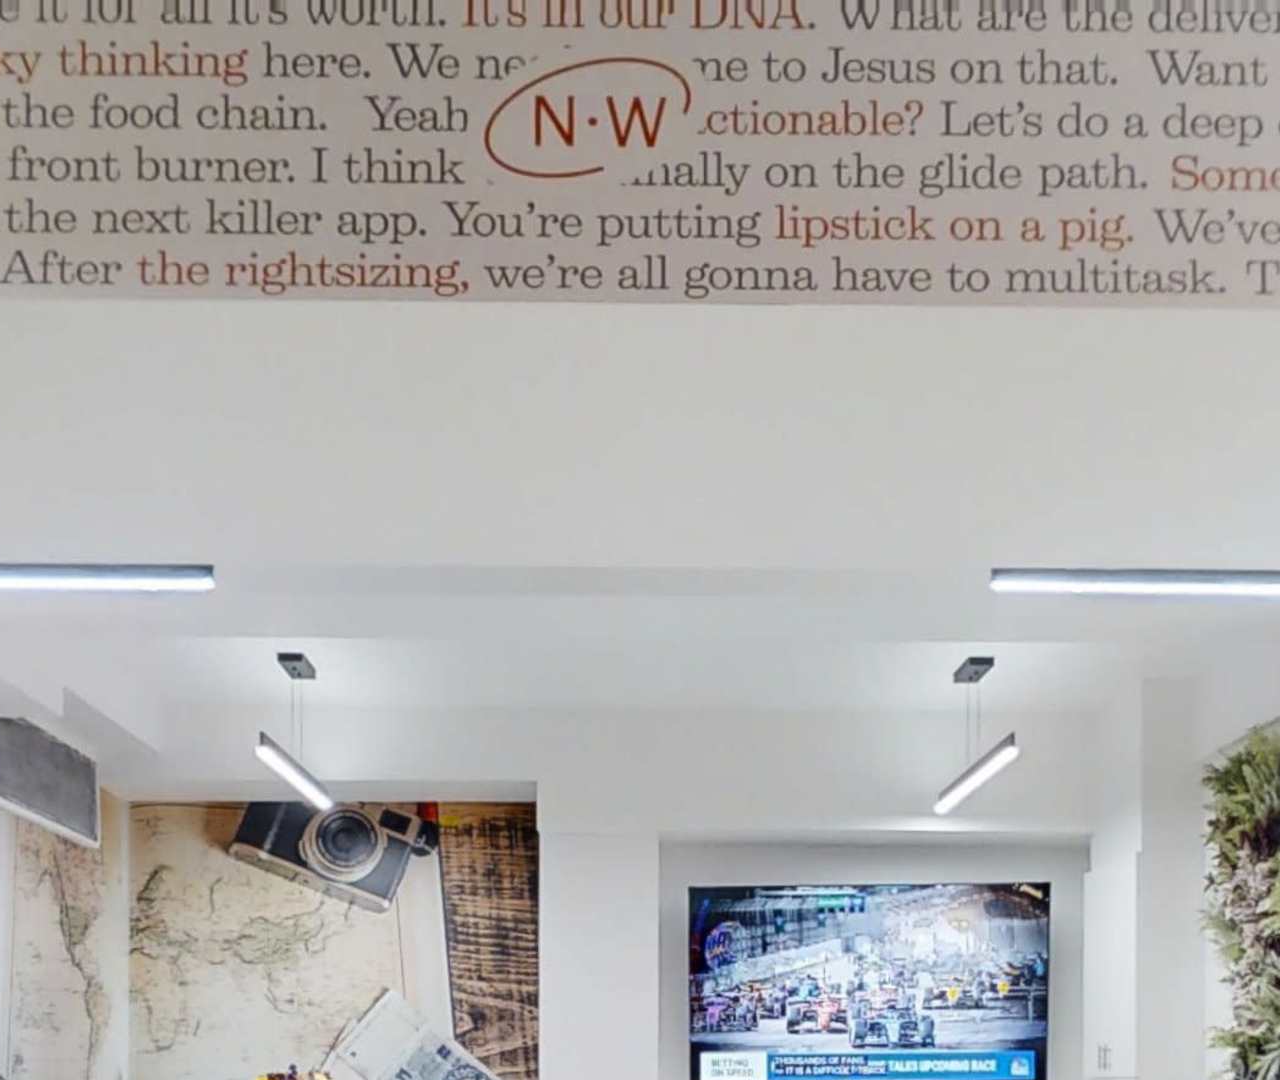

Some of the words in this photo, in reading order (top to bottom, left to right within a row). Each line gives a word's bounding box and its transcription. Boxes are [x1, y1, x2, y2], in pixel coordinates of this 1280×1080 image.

[691, 0, 816, 32] DNA.
[840, 0, 962, 33] What
[976, 5, 1047, 33] are
[1064, 0, 1133, 34] the
[59, 39, 249, 90] thinking
[263, 40, 371, 80] here.
[386, 40, 460, 81] We
[762, 49, 807, 84] to
[821, 44, 936, 85] Jesus
[950, 57, 1003, 86] on
[1017, 46, 1118, 86] that.
[1146, 47, 1268, 87] Want
[1, 89, 75, 130] the
[89, 90, 180, 131] food
[196, 91, 327, 132] chain.
[364, 92, 469, 133] Yeah
[941, 98, 1043, 139] Let's
[1056, 99, 1109, 139] do
[1123, 111, 1149, 139] a
[1162, 99, 1264, 150] deep
[8, 142, 121, 183] front
[136, 143, 295, 185] burner.
[311, 145, 330, 185] I
[343, 145, 465, 186] think
[764, 161, 818, 189] on
[833, 150, 905, 190] the
[919, 151, 1022, 202] glide
[1039, 152, 1148, 202] path.
[4, 194, 77, 235] the
[92, 200, 191, 236] next
[206, 197, 323, 238] killer
[337, 210, 427, 249] app.
[443, 199, 583, 240] You're
[597, 200, 762, 251] putting
[775, 201, 936, 253] lipstick
[949, 215, 1003, 243] on
[1020, 216, 1046, 244] a
[1059, 204, 1134, 254] pig.
[0, 247, 123, 288] After
[137, 248, 210, 289] the
[225, 249, 469, 301] rightsizing,
[483, 251, 603, 292] we're
[617, 252, 670, 292] all
[685, 264, 818, 303] gonna
[832, 253, 932, 294] have
[946, 259, 991, 294] to
[1005, 254, 1227, 297] multitask.
